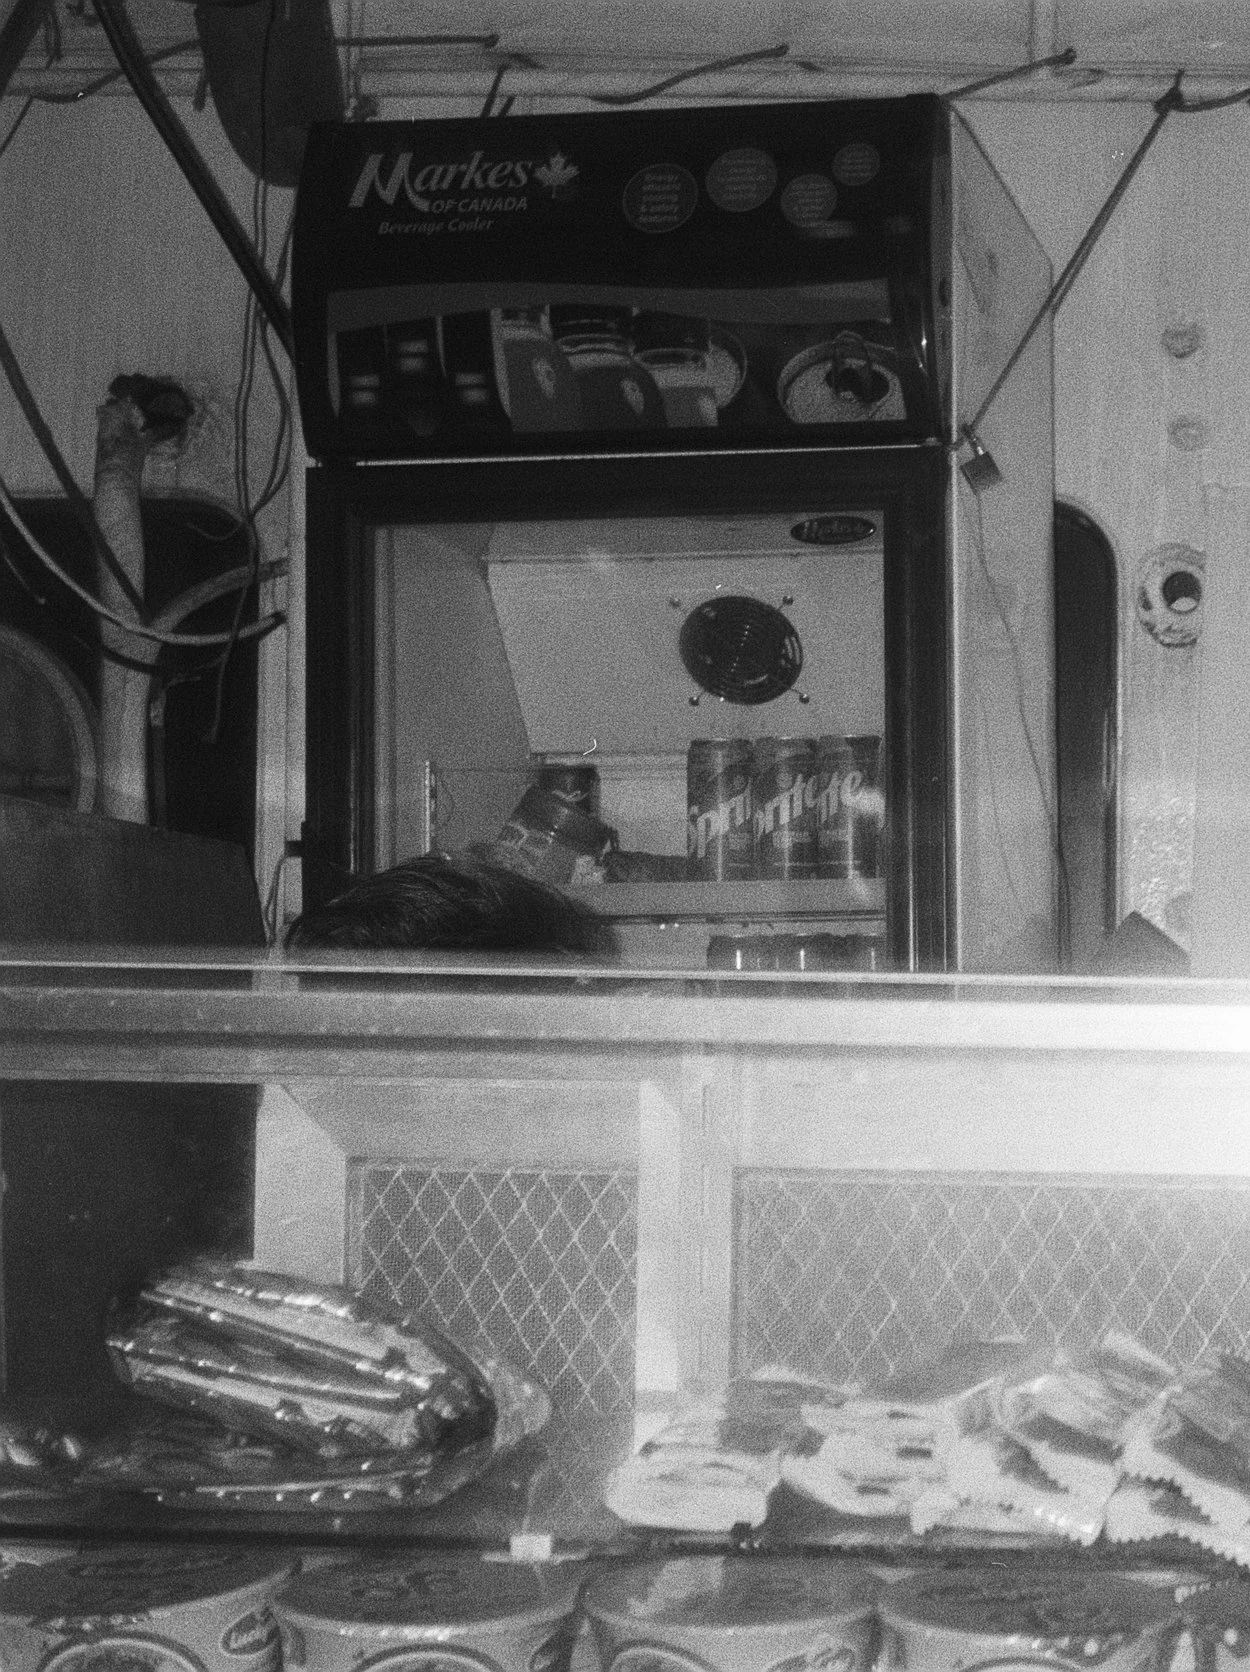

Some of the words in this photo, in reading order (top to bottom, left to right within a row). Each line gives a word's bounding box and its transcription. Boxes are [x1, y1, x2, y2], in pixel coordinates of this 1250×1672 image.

[348, 150, 533, 213] Markes
[432, 199, 458, 214] OF
[457, 196, 528, 212] CANADA
[378, 220, 444, 236] Beverage
[447, 218, 494, 232] Cooler
[687, 776, 751, 858] Sprit
[753, 772, 817, 844] prite
